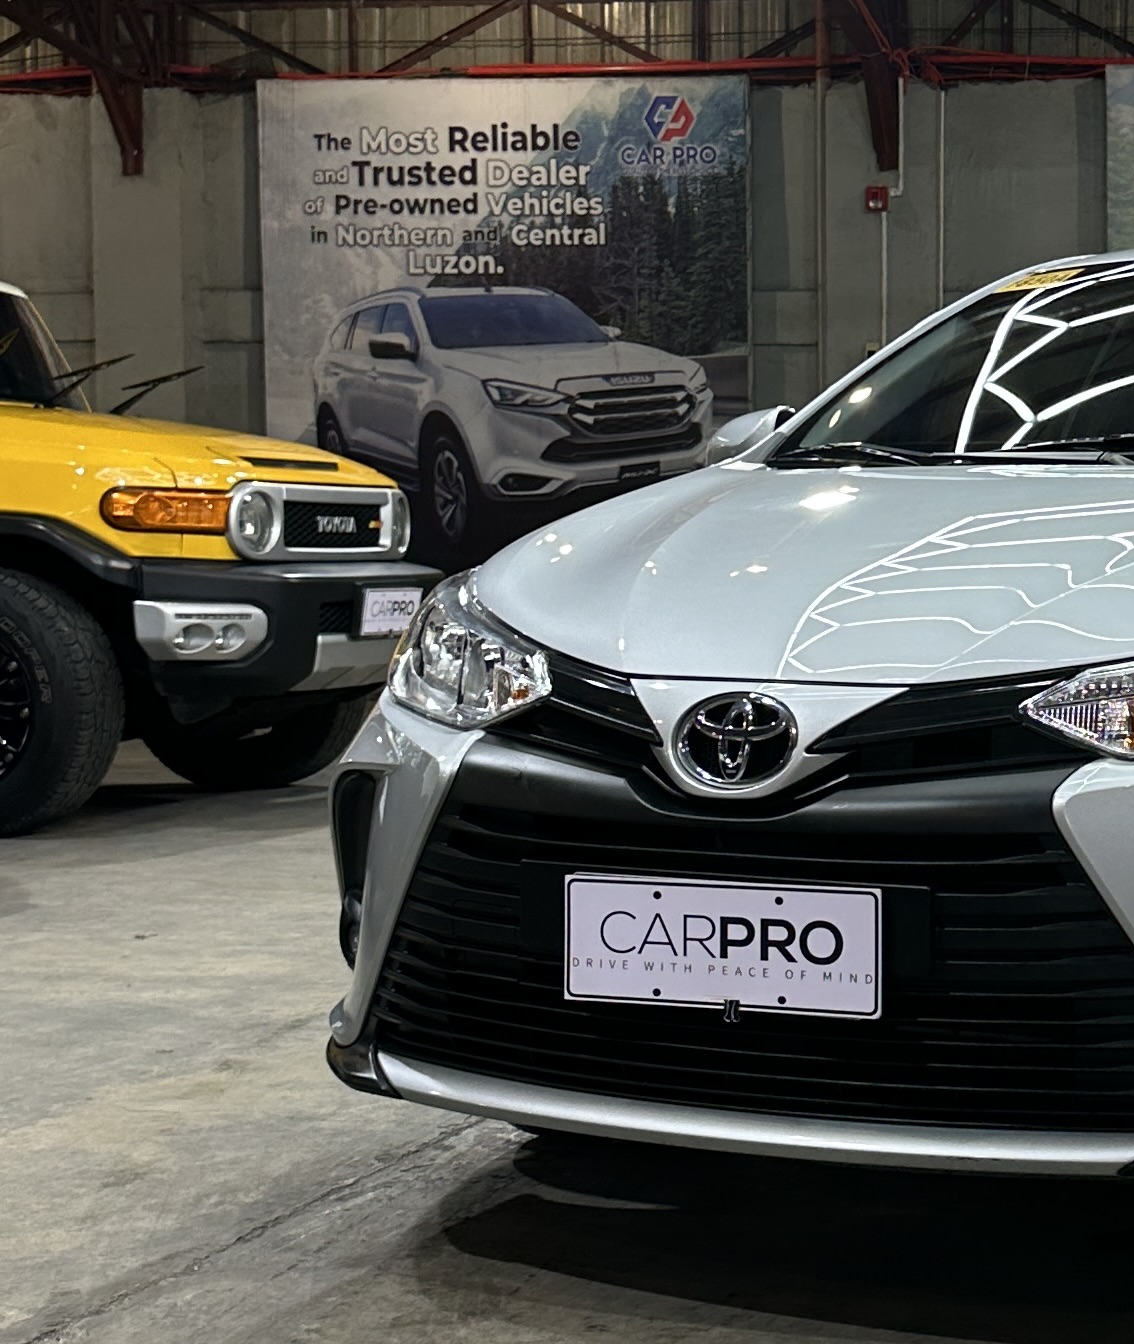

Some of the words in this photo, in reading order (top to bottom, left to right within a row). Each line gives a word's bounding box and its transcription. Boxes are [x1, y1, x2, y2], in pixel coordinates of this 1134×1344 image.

[314, 133, 352, 152] The
[360, 126, 439, 155] Most
[448, 122, 581, 153] Reliable
[621, 145, 665, 165] CAR
[672, 145, 717, 165] PRO
[313, 166, 348, 184] and
[352, 158, 478, 186] Trusted
[487, 158, 591, 186] Dealer
[304, 196, 325, 214] of
[334, 193, 478, 215] Pre-owned
[486, 190, 604, 216] Vehicles
[310, 225, 328, 244] in
[336, 223, 454, 247] Northern
[462, 227, 498, 243] and
[511, 223, 606, 247] Central
[407, 250, 505, 276] Luzon.
[317, 516, 357, 533] TOYOTA
[371, 600, 415, 617] CARPRO
[600, 911, 844, 966] CARPRO
[572, 957, 629, 970] DRIVE
[644, 961, 692, 974] WITH
[708, 965, 770, 978] PEACE
[785, 969, 807, 981] OF
[823, 972, 873, 985] MIND
